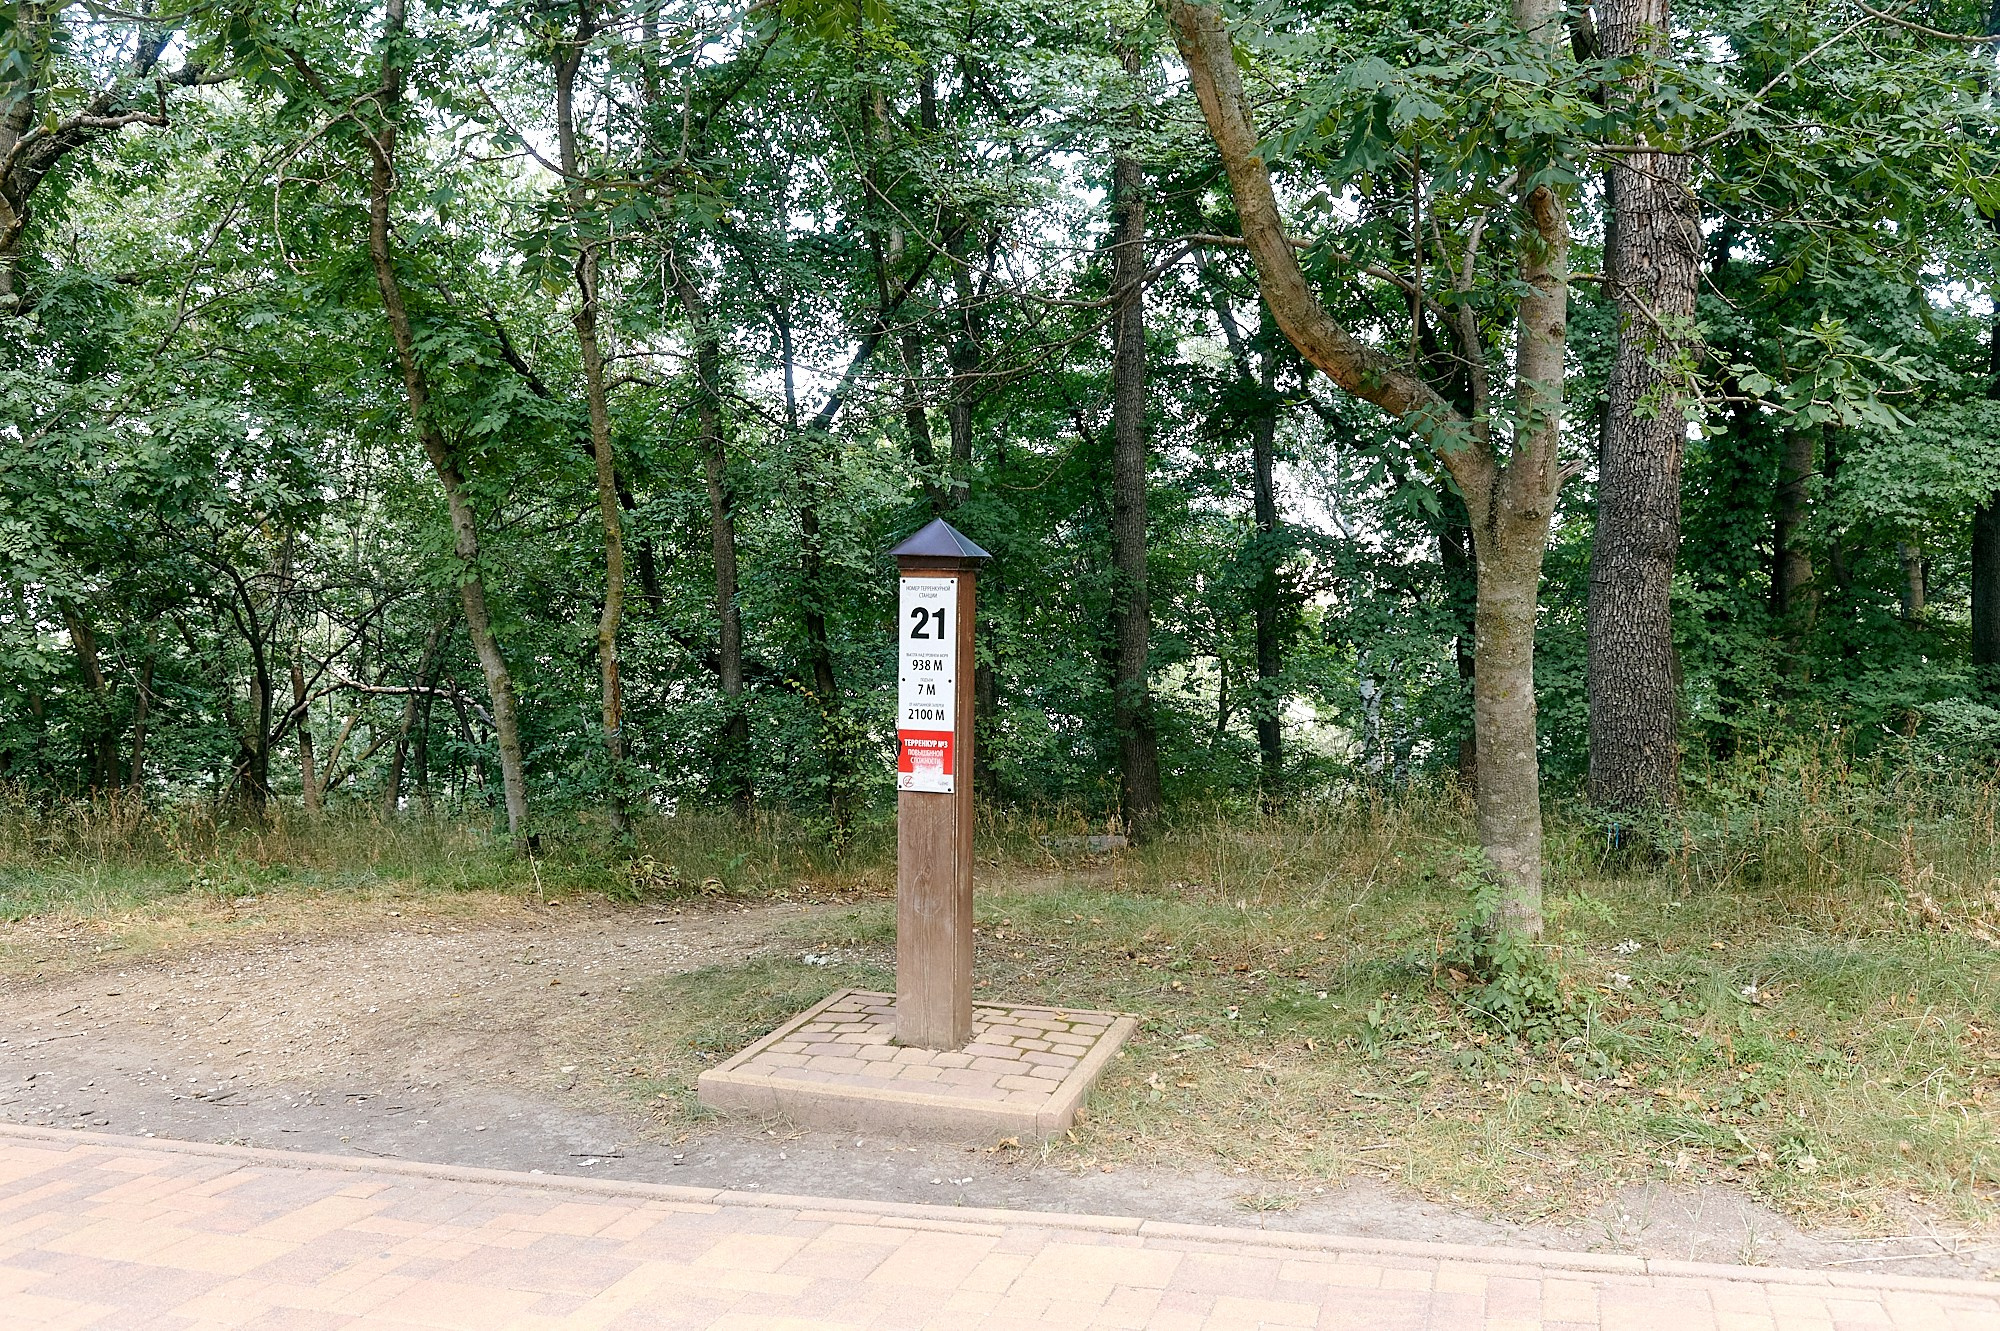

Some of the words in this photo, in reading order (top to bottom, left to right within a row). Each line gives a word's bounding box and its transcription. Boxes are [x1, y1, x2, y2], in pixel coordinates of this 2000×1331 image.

[910, 606, 945, 640] 21
[912, 659, 931, 671] 938
[934, 660, 942, 671] М
[918, 684, 924, 695] 7
[926, 684, 936, 695] М
[908, 708, 932, 720] 2100
[935, 709, 944, 720] М
[904, 739, 937, 748] ТЕРРЕНКУР
